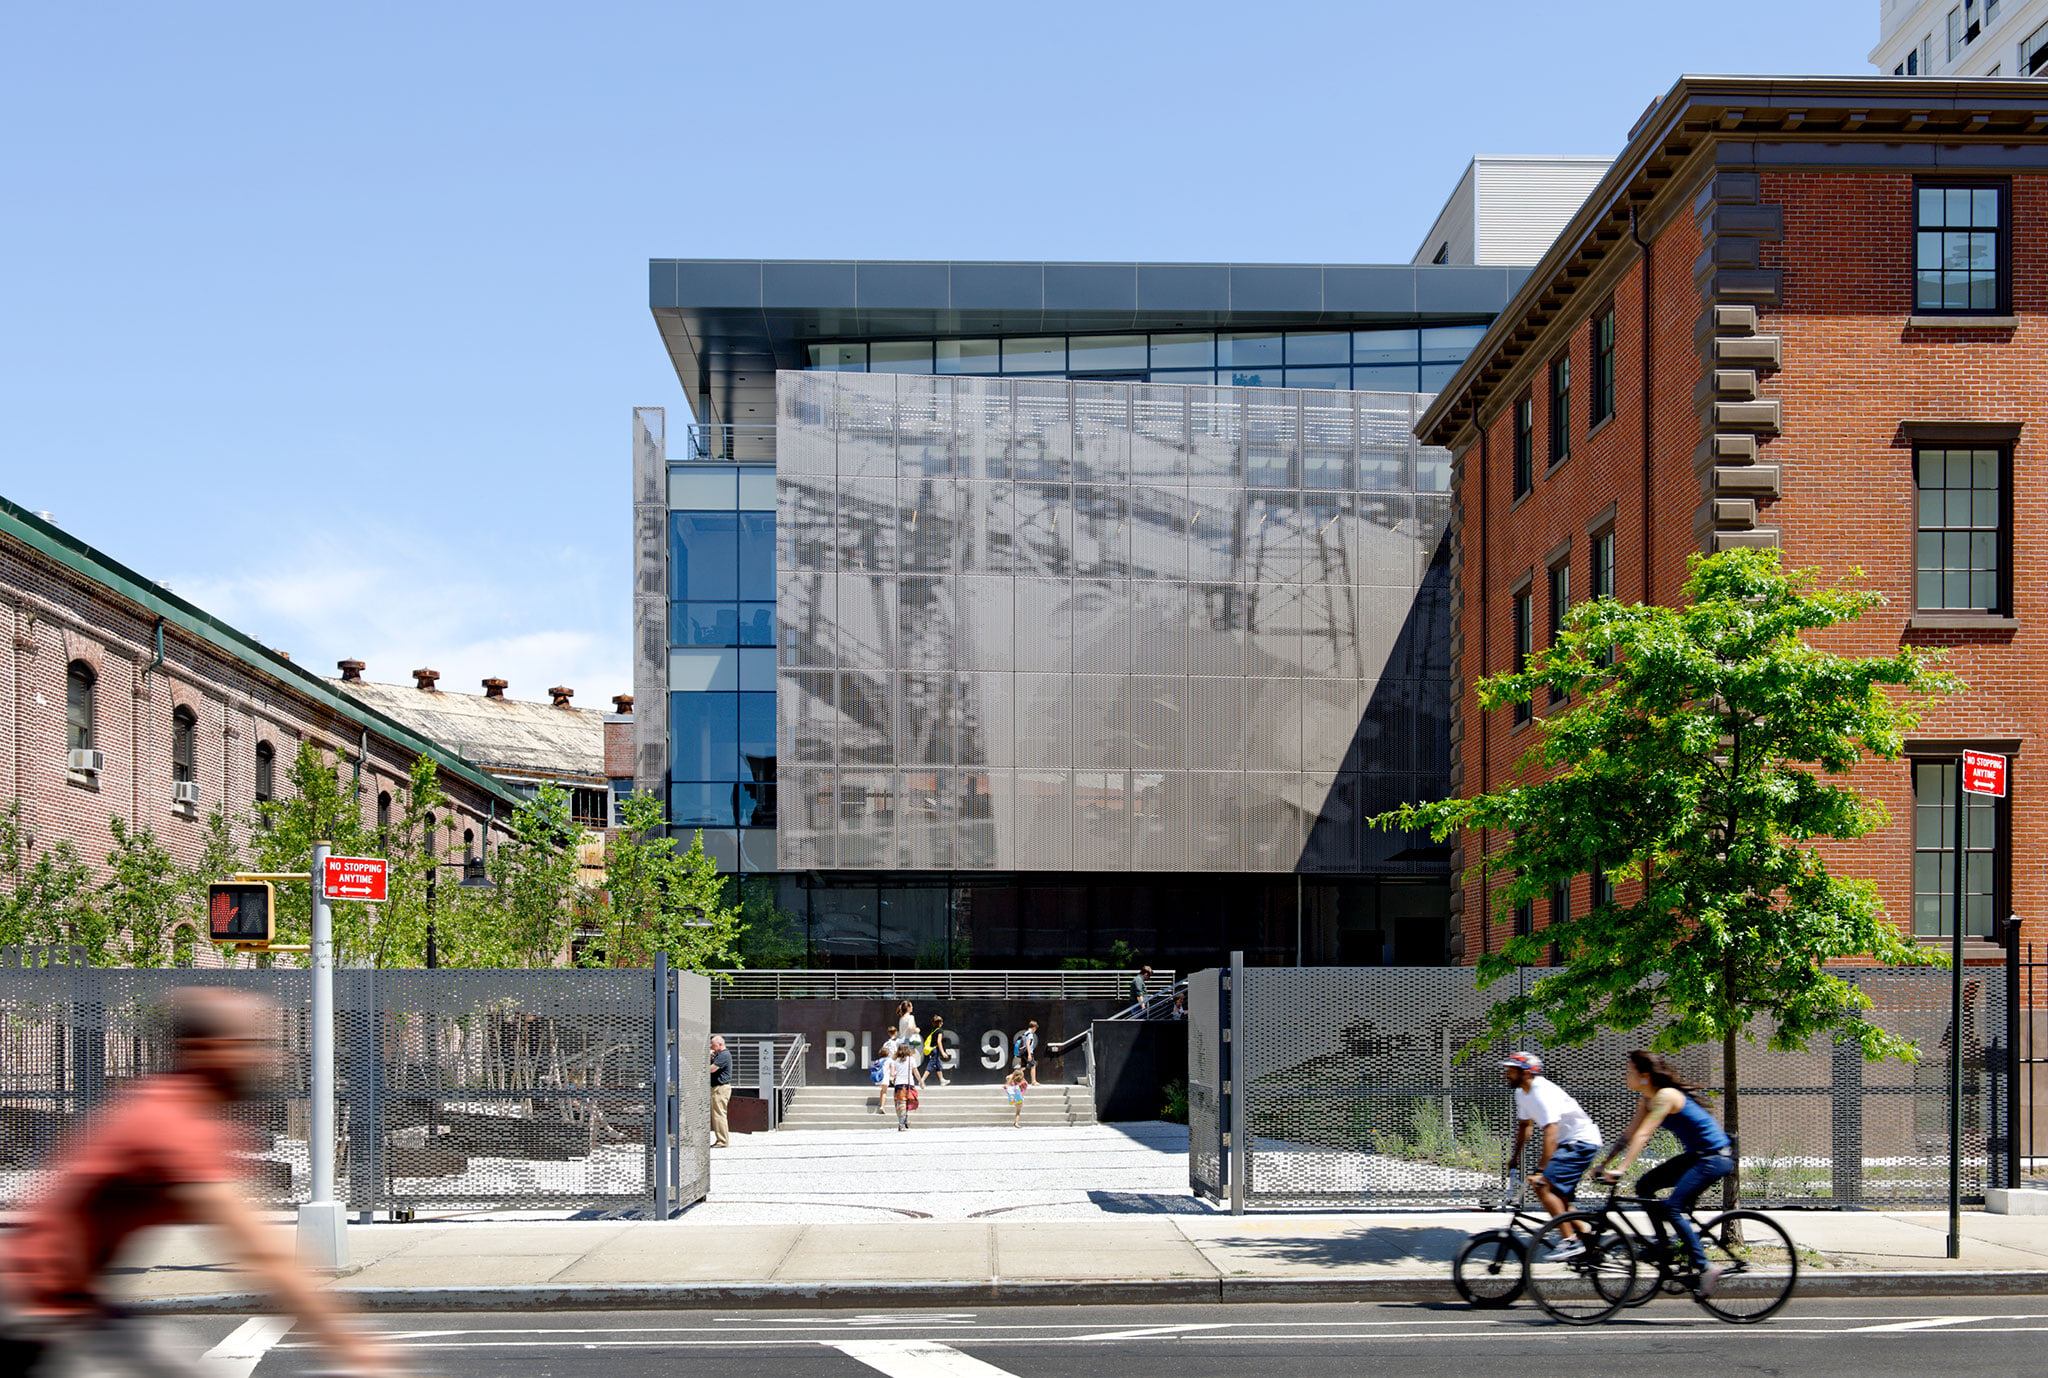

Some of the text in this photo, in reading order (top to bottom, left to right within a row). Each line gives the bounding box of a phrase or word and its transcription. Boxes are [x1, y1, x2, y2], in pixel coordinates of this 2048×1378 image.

[1967, 756, 2002, 769] NO STOPPING
[1973, 768, 1996, 779] ANYTIME
[330, 862, 382, 873] NO STOPPING
[339, 874, 373, 884] ANYTIME
